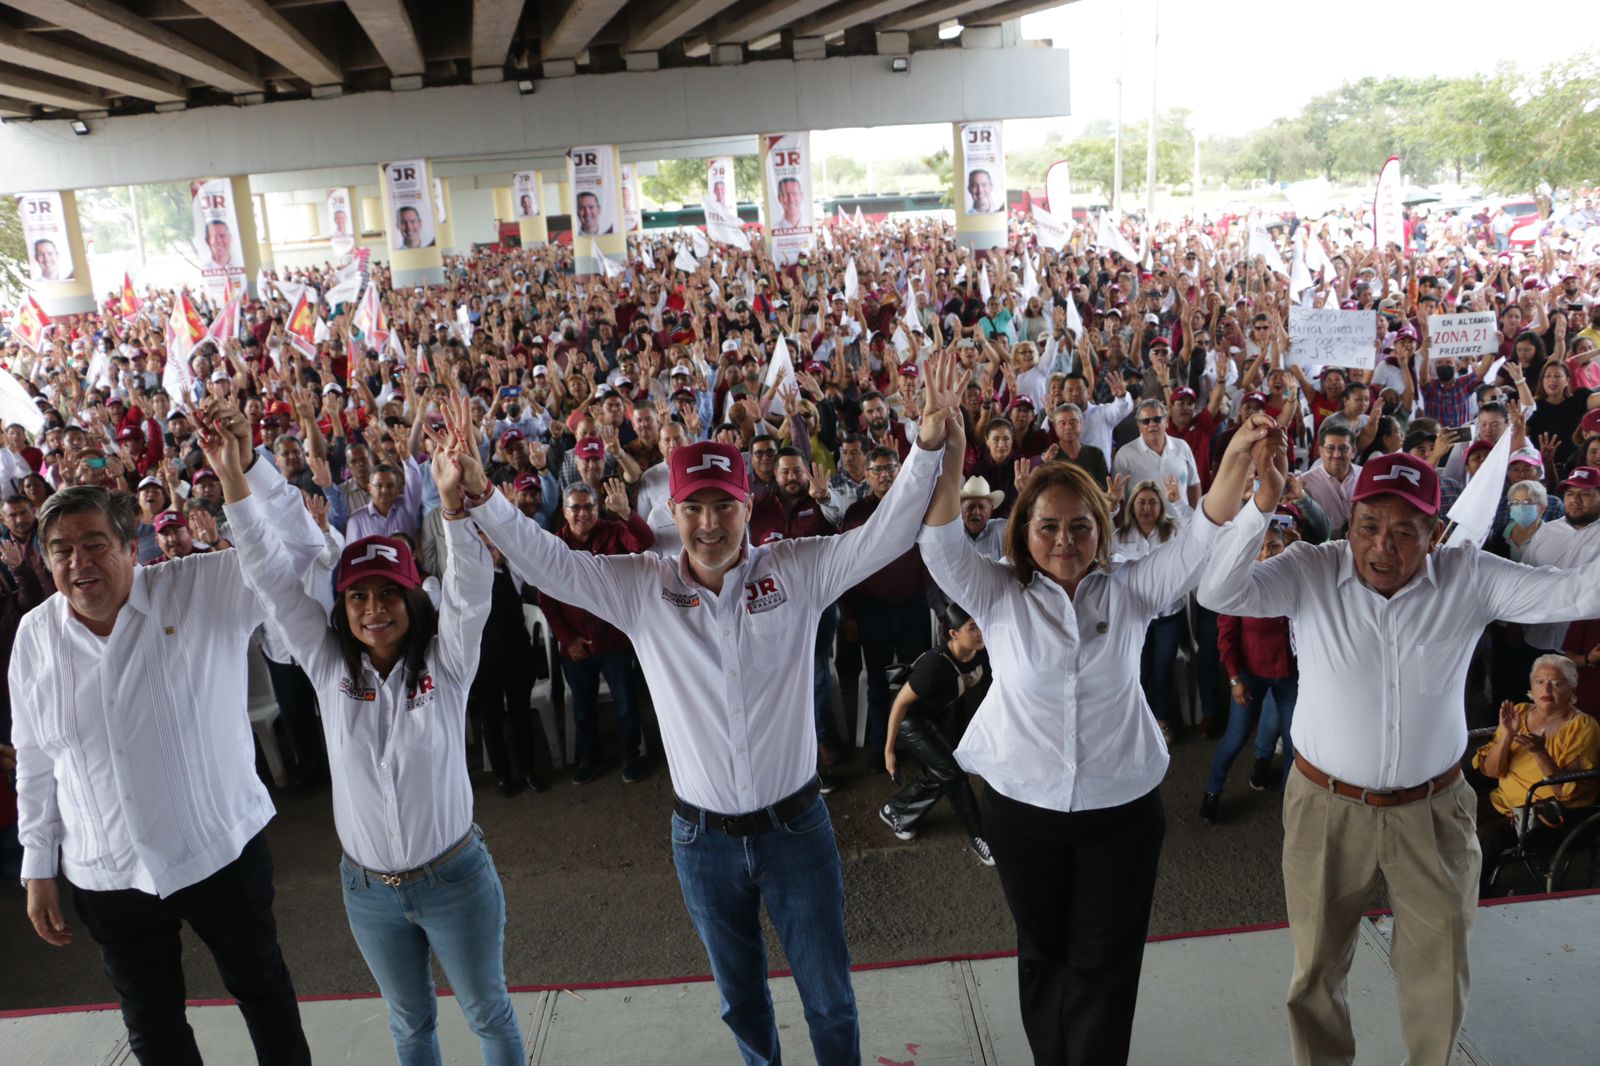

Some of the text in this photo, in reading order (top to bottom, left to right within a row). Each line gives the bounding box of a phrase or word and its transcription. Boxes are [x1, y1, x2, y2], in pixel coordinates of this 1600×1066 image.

[968, 129, 992, 144] JR
[573, 151, 598, 167] JR
[775, 150, 801, 168] JR
[391, 166, 417, 182] JR
[27, 200, 52, 215] JR
[200, 194, 226, 211] JR
[1442, 316, 1494, 327] EN ALTAMIRA
[1434, 328, 1488, 344] ZONA 21
[1439, 345, 1483, 355] PRESENTE
[686, 453, 733, 474] JR
[1372, 464, 1422, 488] JR
[350, 543, 401, 566] JR
[745, 576, 779, 601] JR
